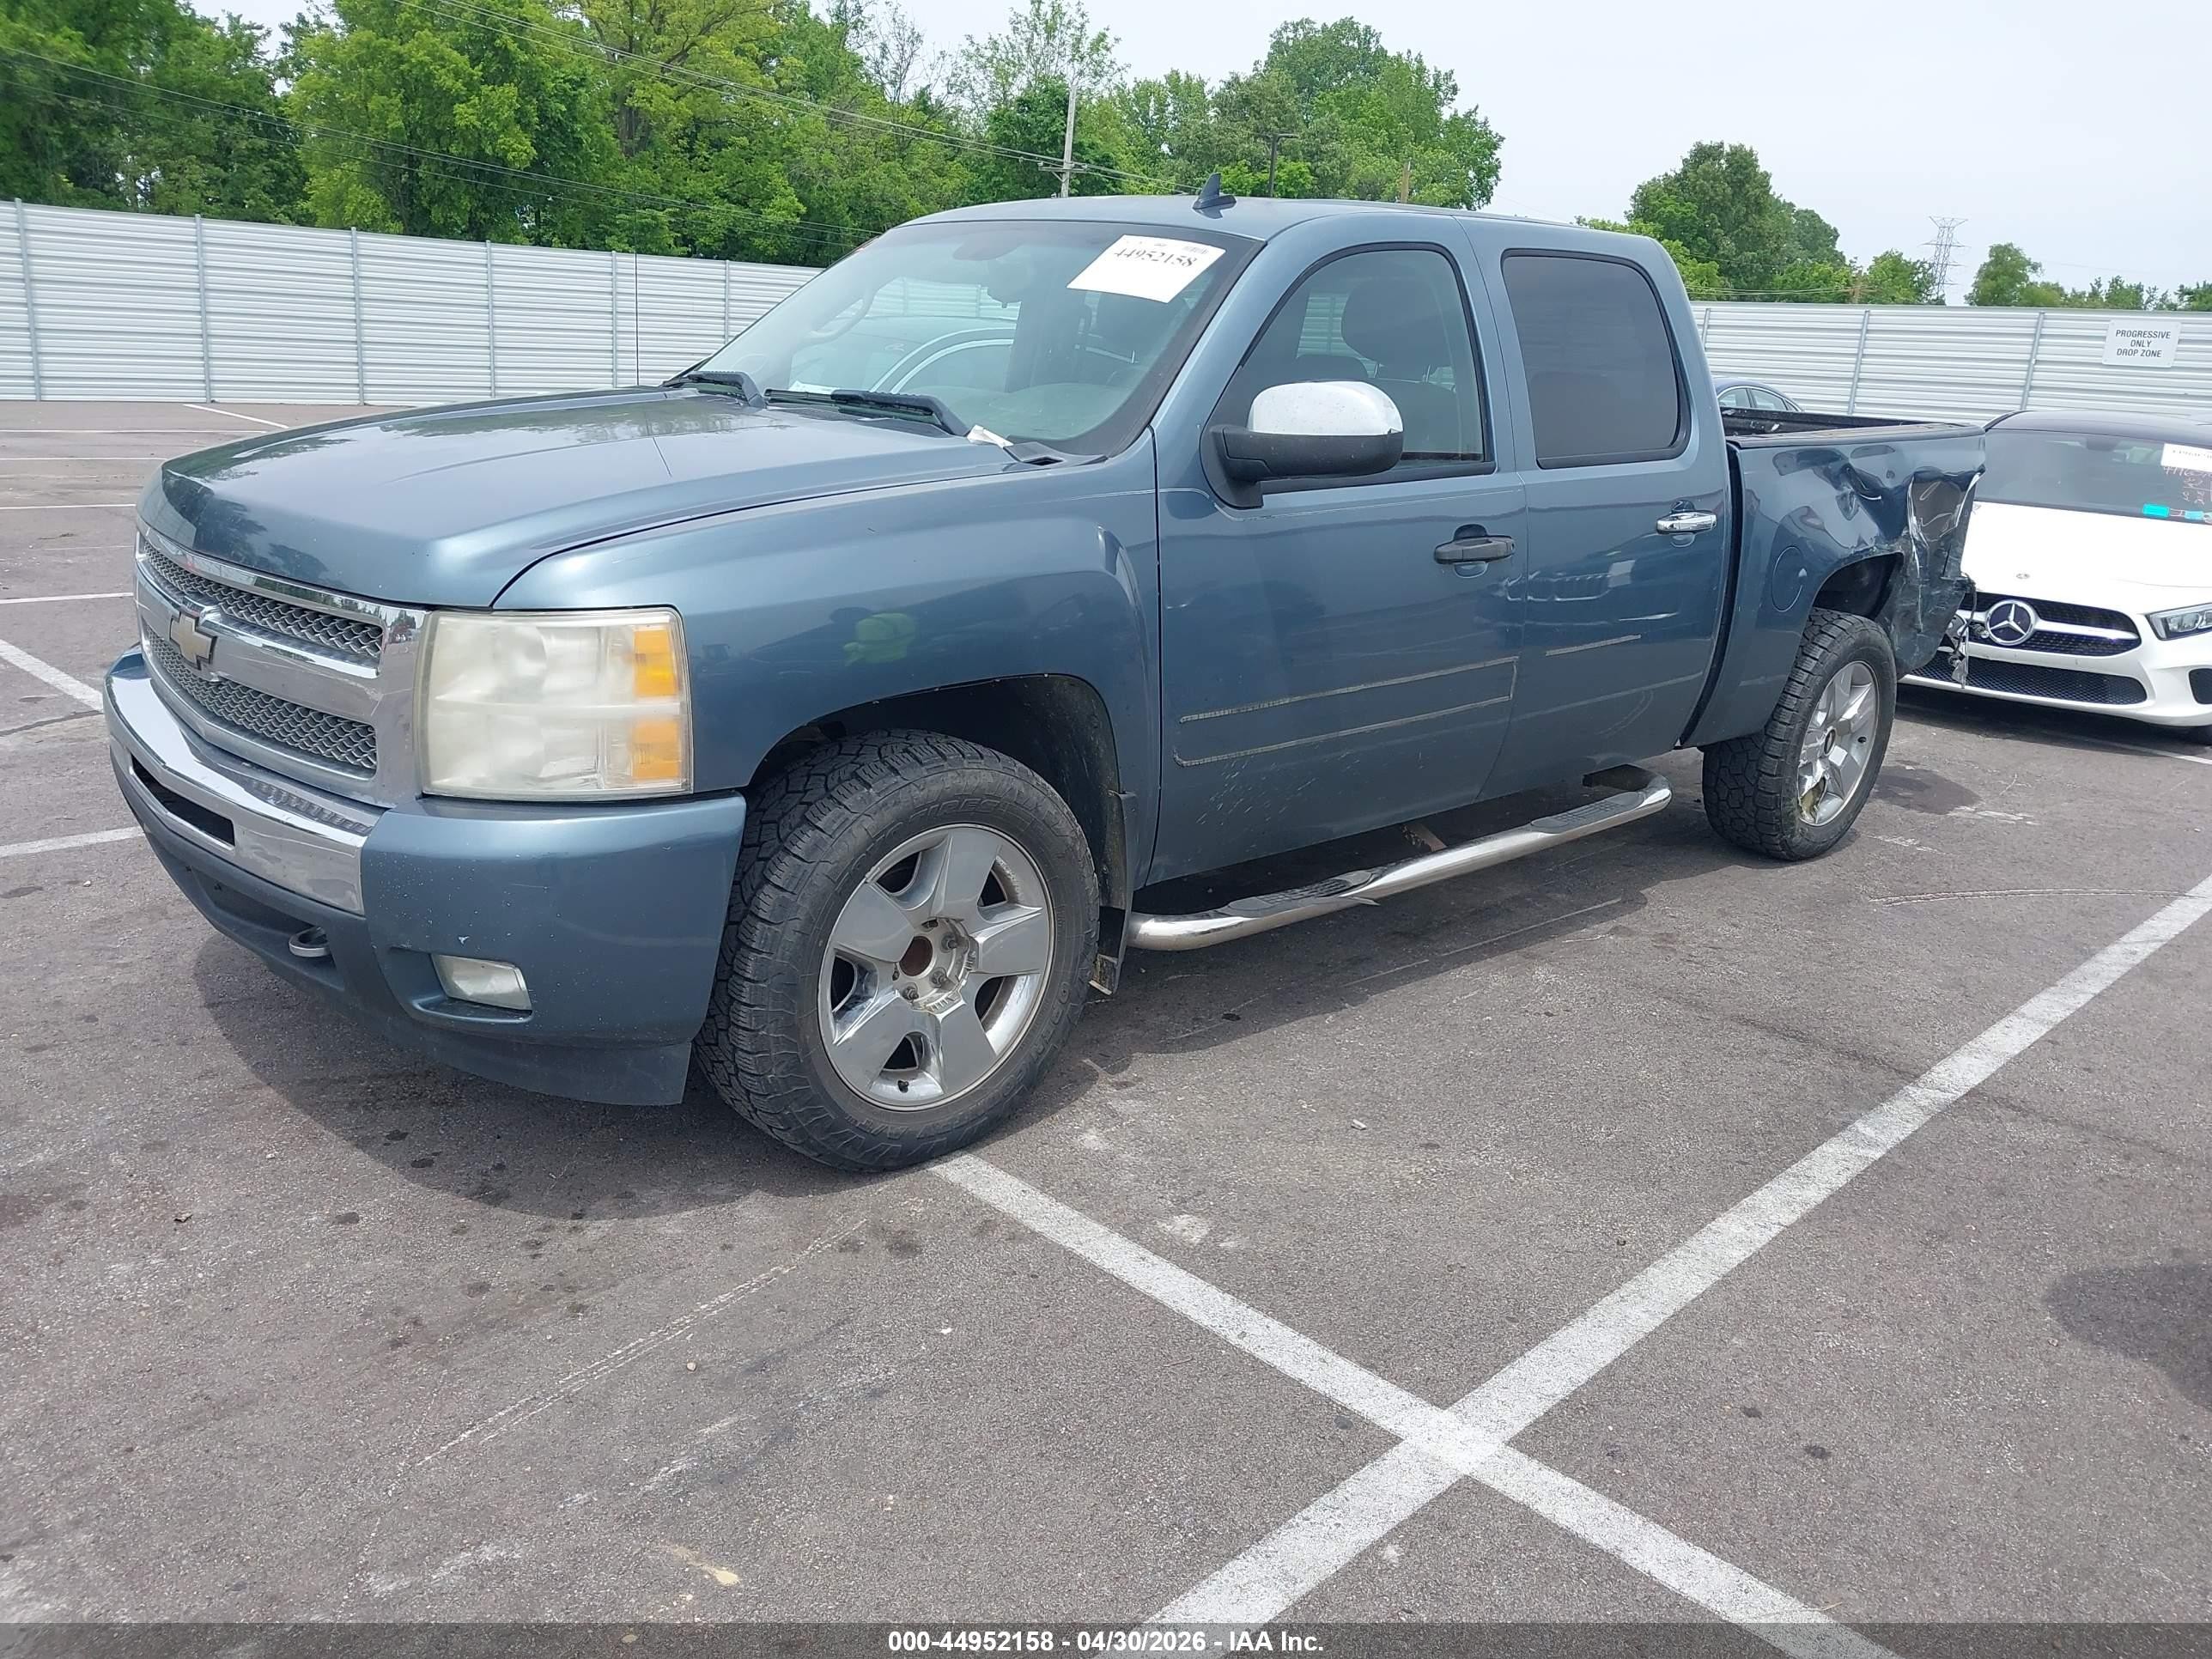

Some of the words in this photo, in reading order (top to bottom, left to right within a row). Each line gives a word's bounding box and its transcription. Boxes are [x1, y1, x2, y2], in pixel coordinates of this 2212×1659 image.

[1114, 247, 1198, 267] 44952158
[2115, 330, 2171, 339] PROGRESSIVE
[2130, 339, 2152, 348] ONLY
[2116, 348, 2139, 357] DROP
